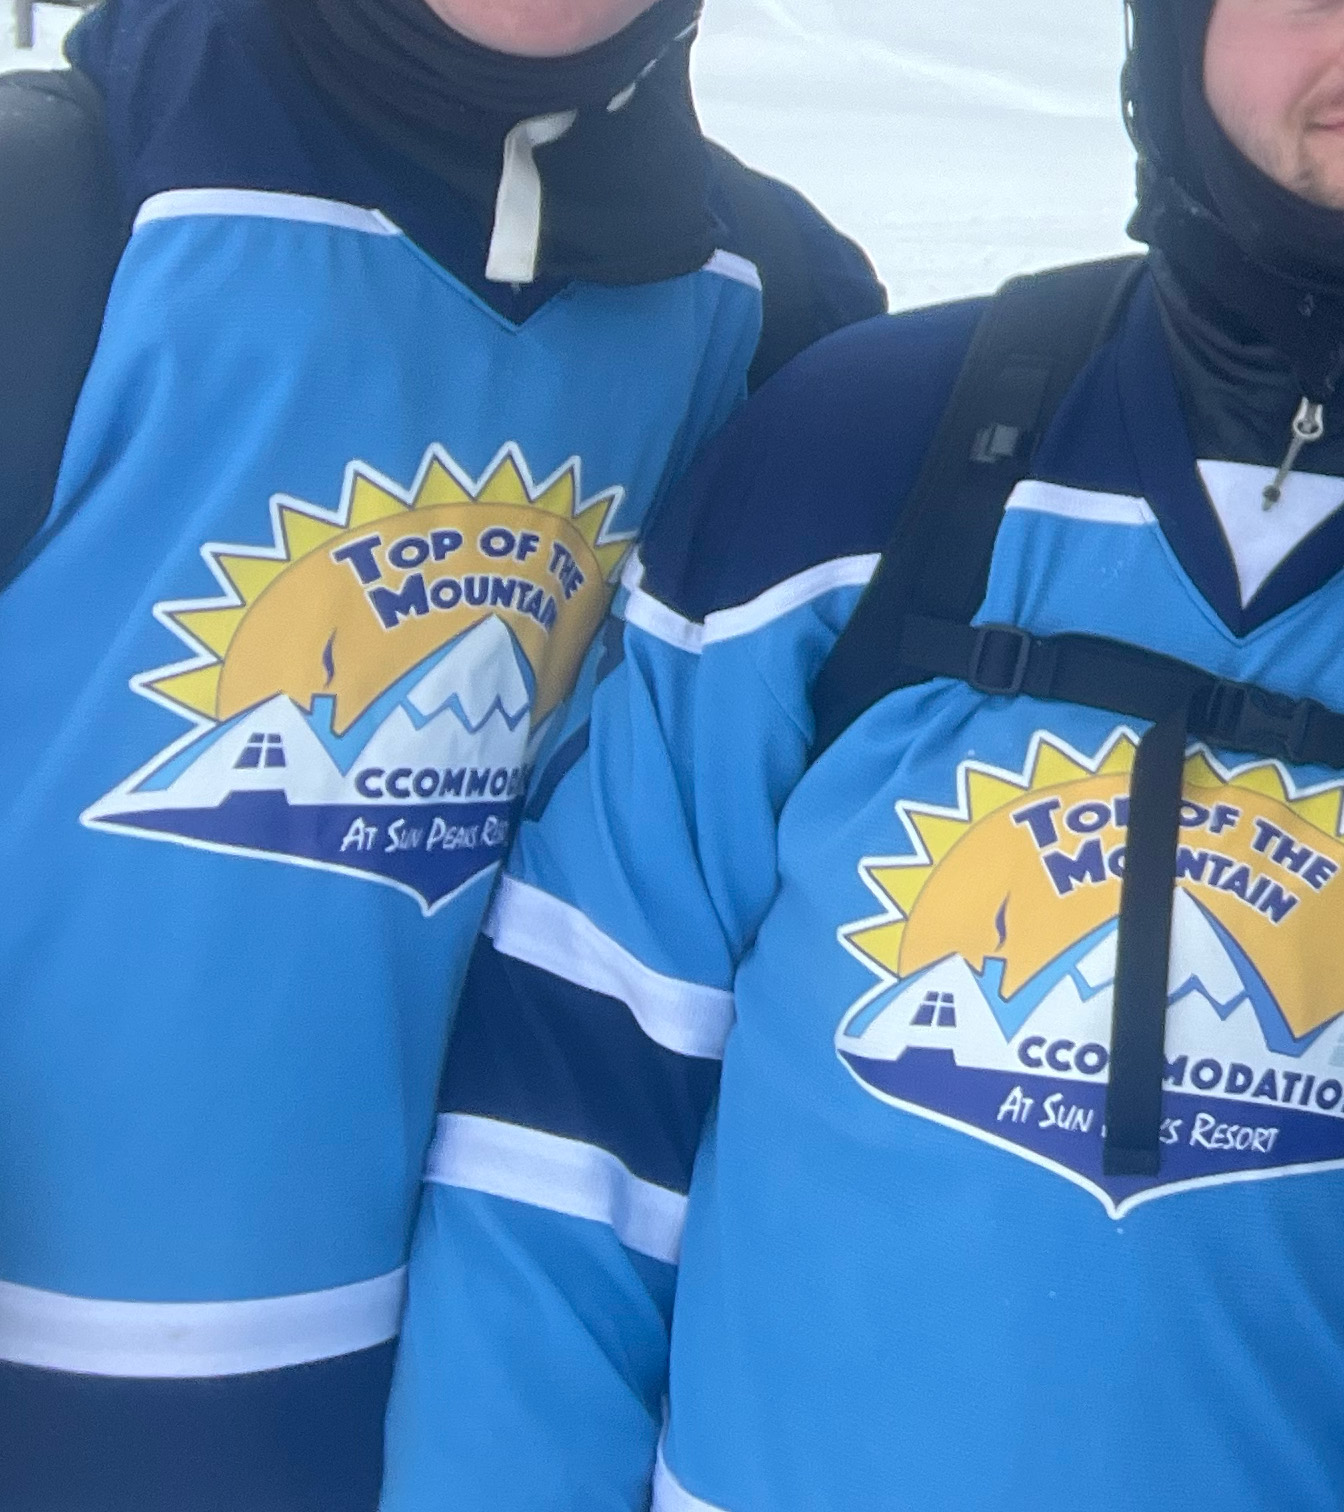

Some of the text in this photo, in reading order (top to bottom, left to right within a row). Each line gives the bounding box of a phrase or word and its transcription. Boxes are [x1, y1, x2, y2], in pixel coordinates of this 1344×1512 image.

[331, 526, 586, 601] TOP OF THE
[339, 816, 379, 852] AT
[1250, 817, 1340, 891] THE
[996, 1085, 1034, 1122] AT
[1038, 1092, 1096, 1134] SUN
[1188, 1112, 1281, 1155] RESORT
